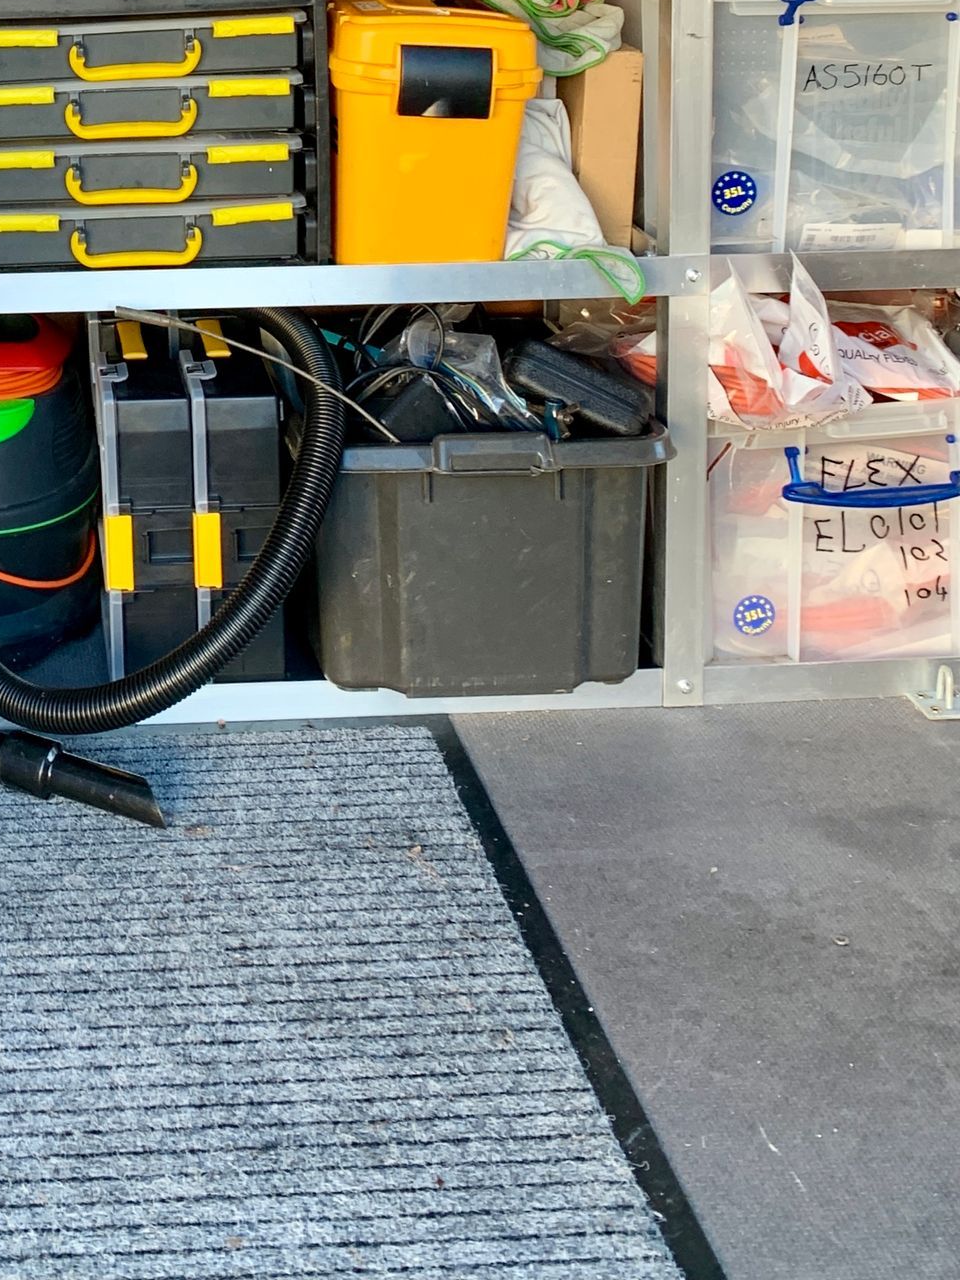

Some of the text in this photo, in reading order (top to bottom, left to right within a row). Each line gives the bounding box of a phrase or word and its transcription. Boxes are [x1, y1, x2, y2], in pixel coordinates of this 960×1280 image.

[802, 63, 934, 92] AS5160T
[721, 198, 753, 214] Capacity
[723, 186, 746, 199] 35L
[820, 455, 923, 492] FLEX
[903, 575, 949, 608] 104
